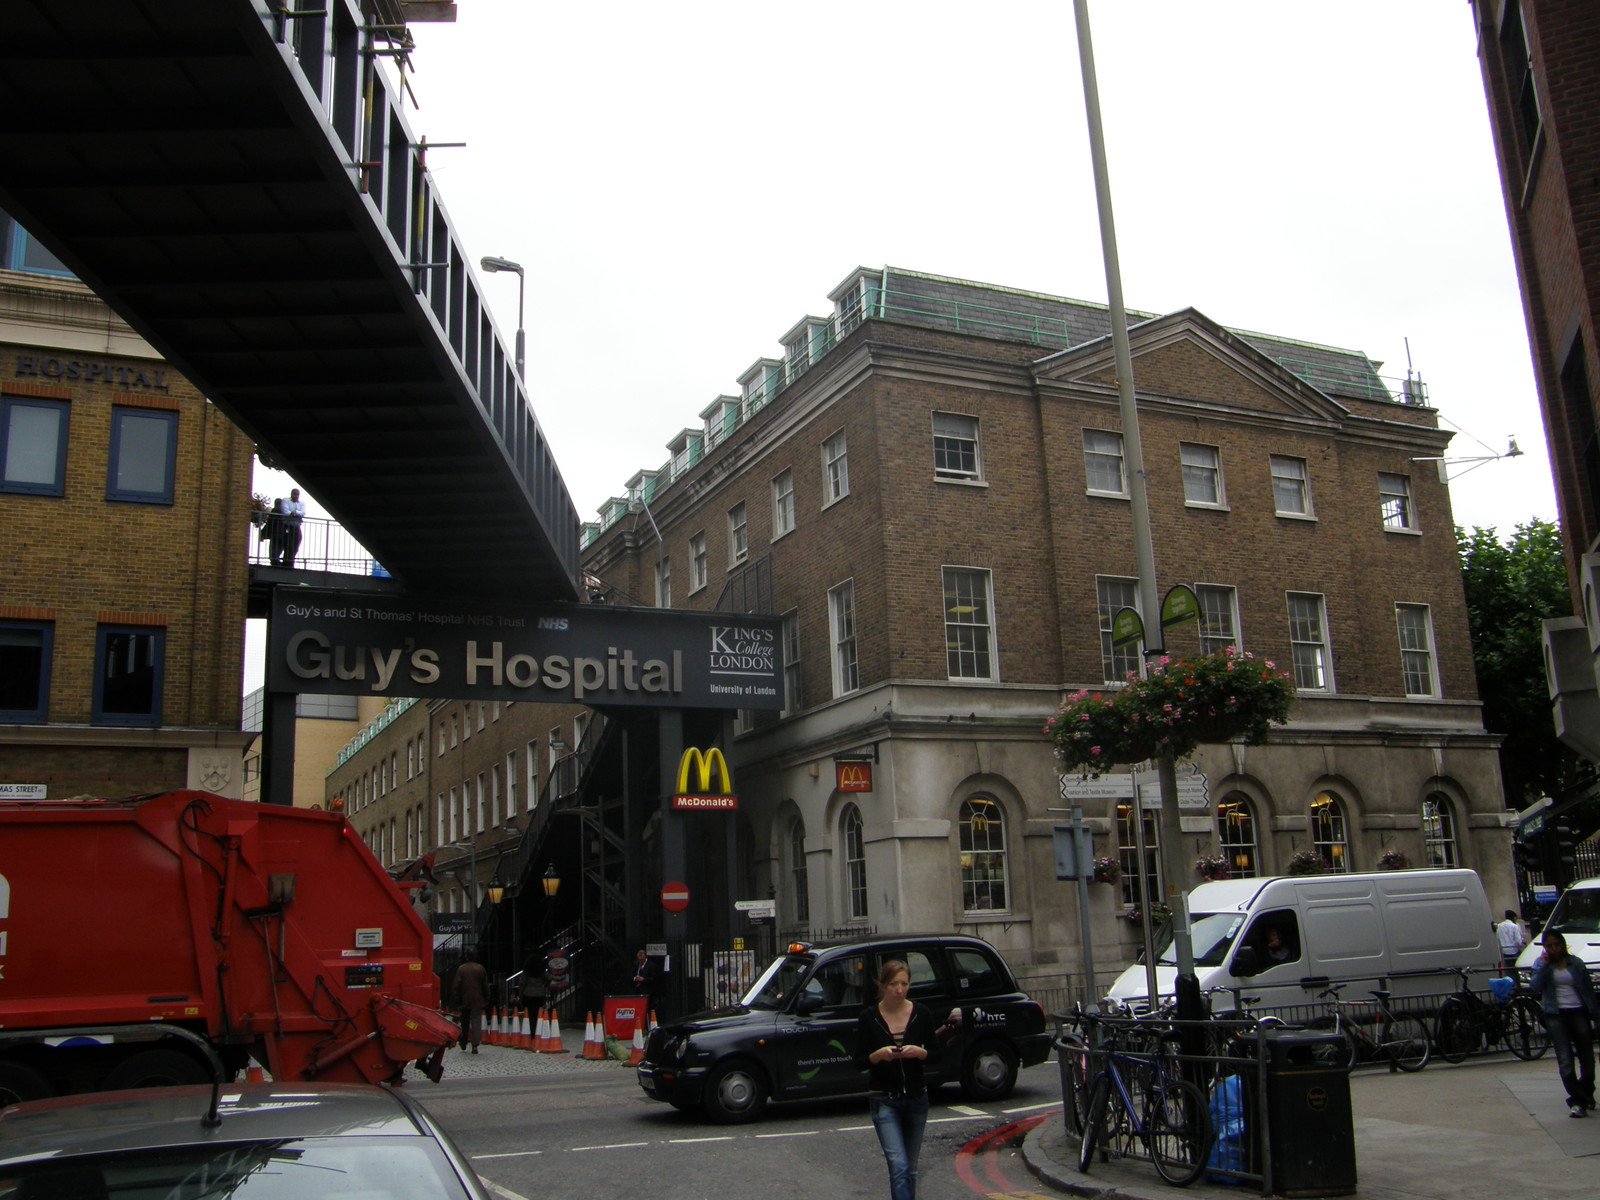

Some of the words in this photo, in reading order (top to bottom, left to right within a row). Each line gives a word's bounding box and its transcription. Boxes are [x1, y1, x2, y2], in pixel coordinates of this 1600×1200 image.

[16, 355, 168, 391] HOSPITAL
[286, 603, 321, 618] Guy's
[324, 607, 347, 618] and
[350, 607, 362, 619] St
[365, 608, 415, 621] Thomas'
[418, 611, 464, 625] Hospital
[467, 614, 494, 626] NHS
[497, 615, 525, 628] Trust
[538, 616, 569, 630] NHS
[709, 626, 774, 654] KING'S
[735, 641, 774, 657] College
[286, 629, 441, 692] Guy's
[709, 654, 774, 670] LONDON
[466, 640, 683, 699] Hospital
[710, 684, 743, 696] University
[745, 685, 752, 695] of
[753, 685, 776, 695] London
[16, 785, 38, 793] STREET
[677, 797, 734, 807] McDonald's
[438, 924, 457, 932] Guy's
